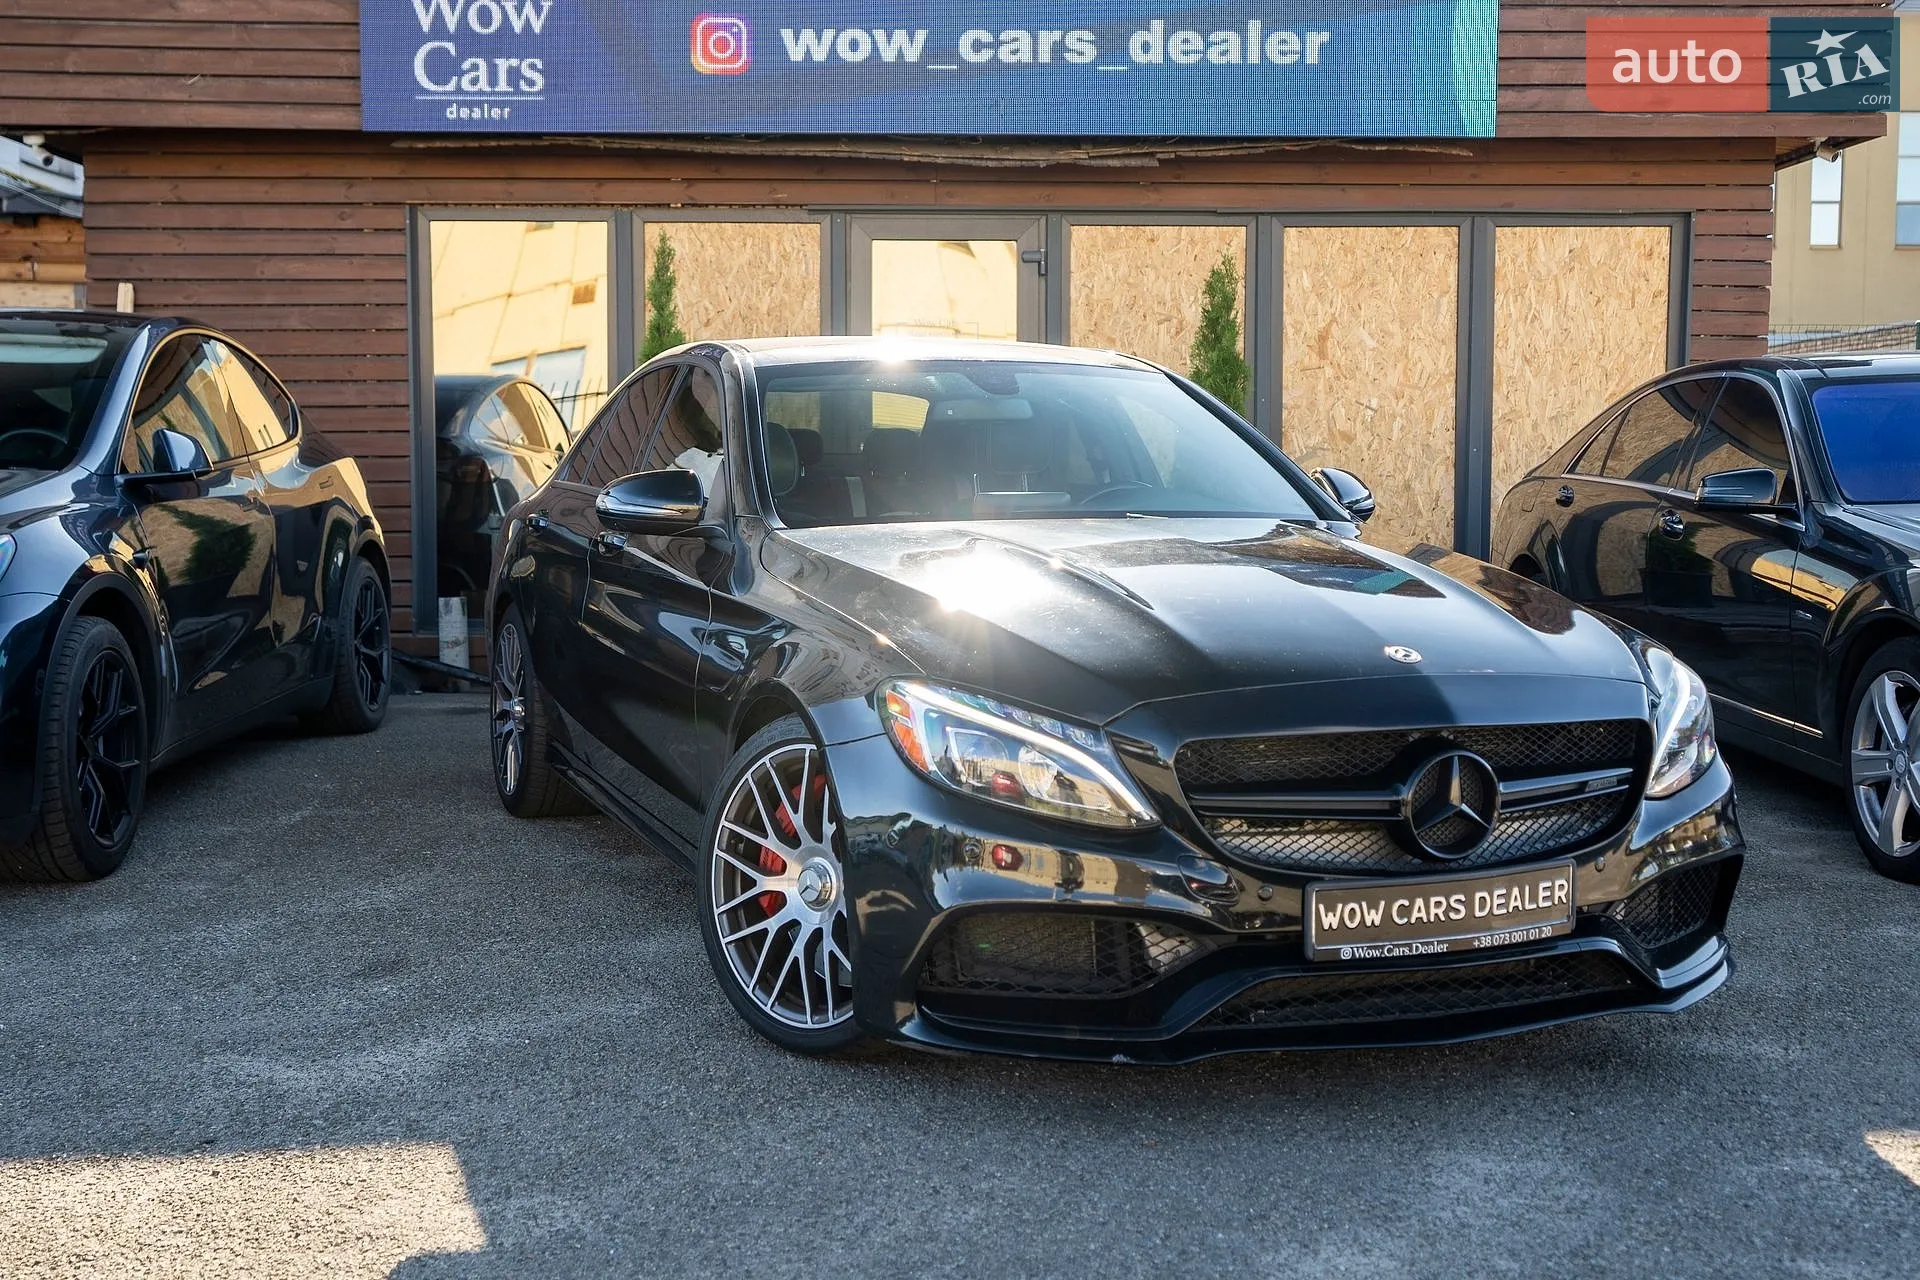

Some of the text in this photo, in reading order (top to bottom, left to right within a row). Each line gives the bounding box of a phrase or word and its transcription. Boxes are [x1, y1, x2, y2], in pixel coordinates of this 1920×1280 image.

[413, 41, 545, 93] Cars
[780, 20, 1330, 70] wow_cars_dealer
[446, 102, 511, 120] dealer
[1318, 879, 1569, 930] WOW CARS DEALER
[1473, 926, 1552, 948] +38 073 001 01 20
